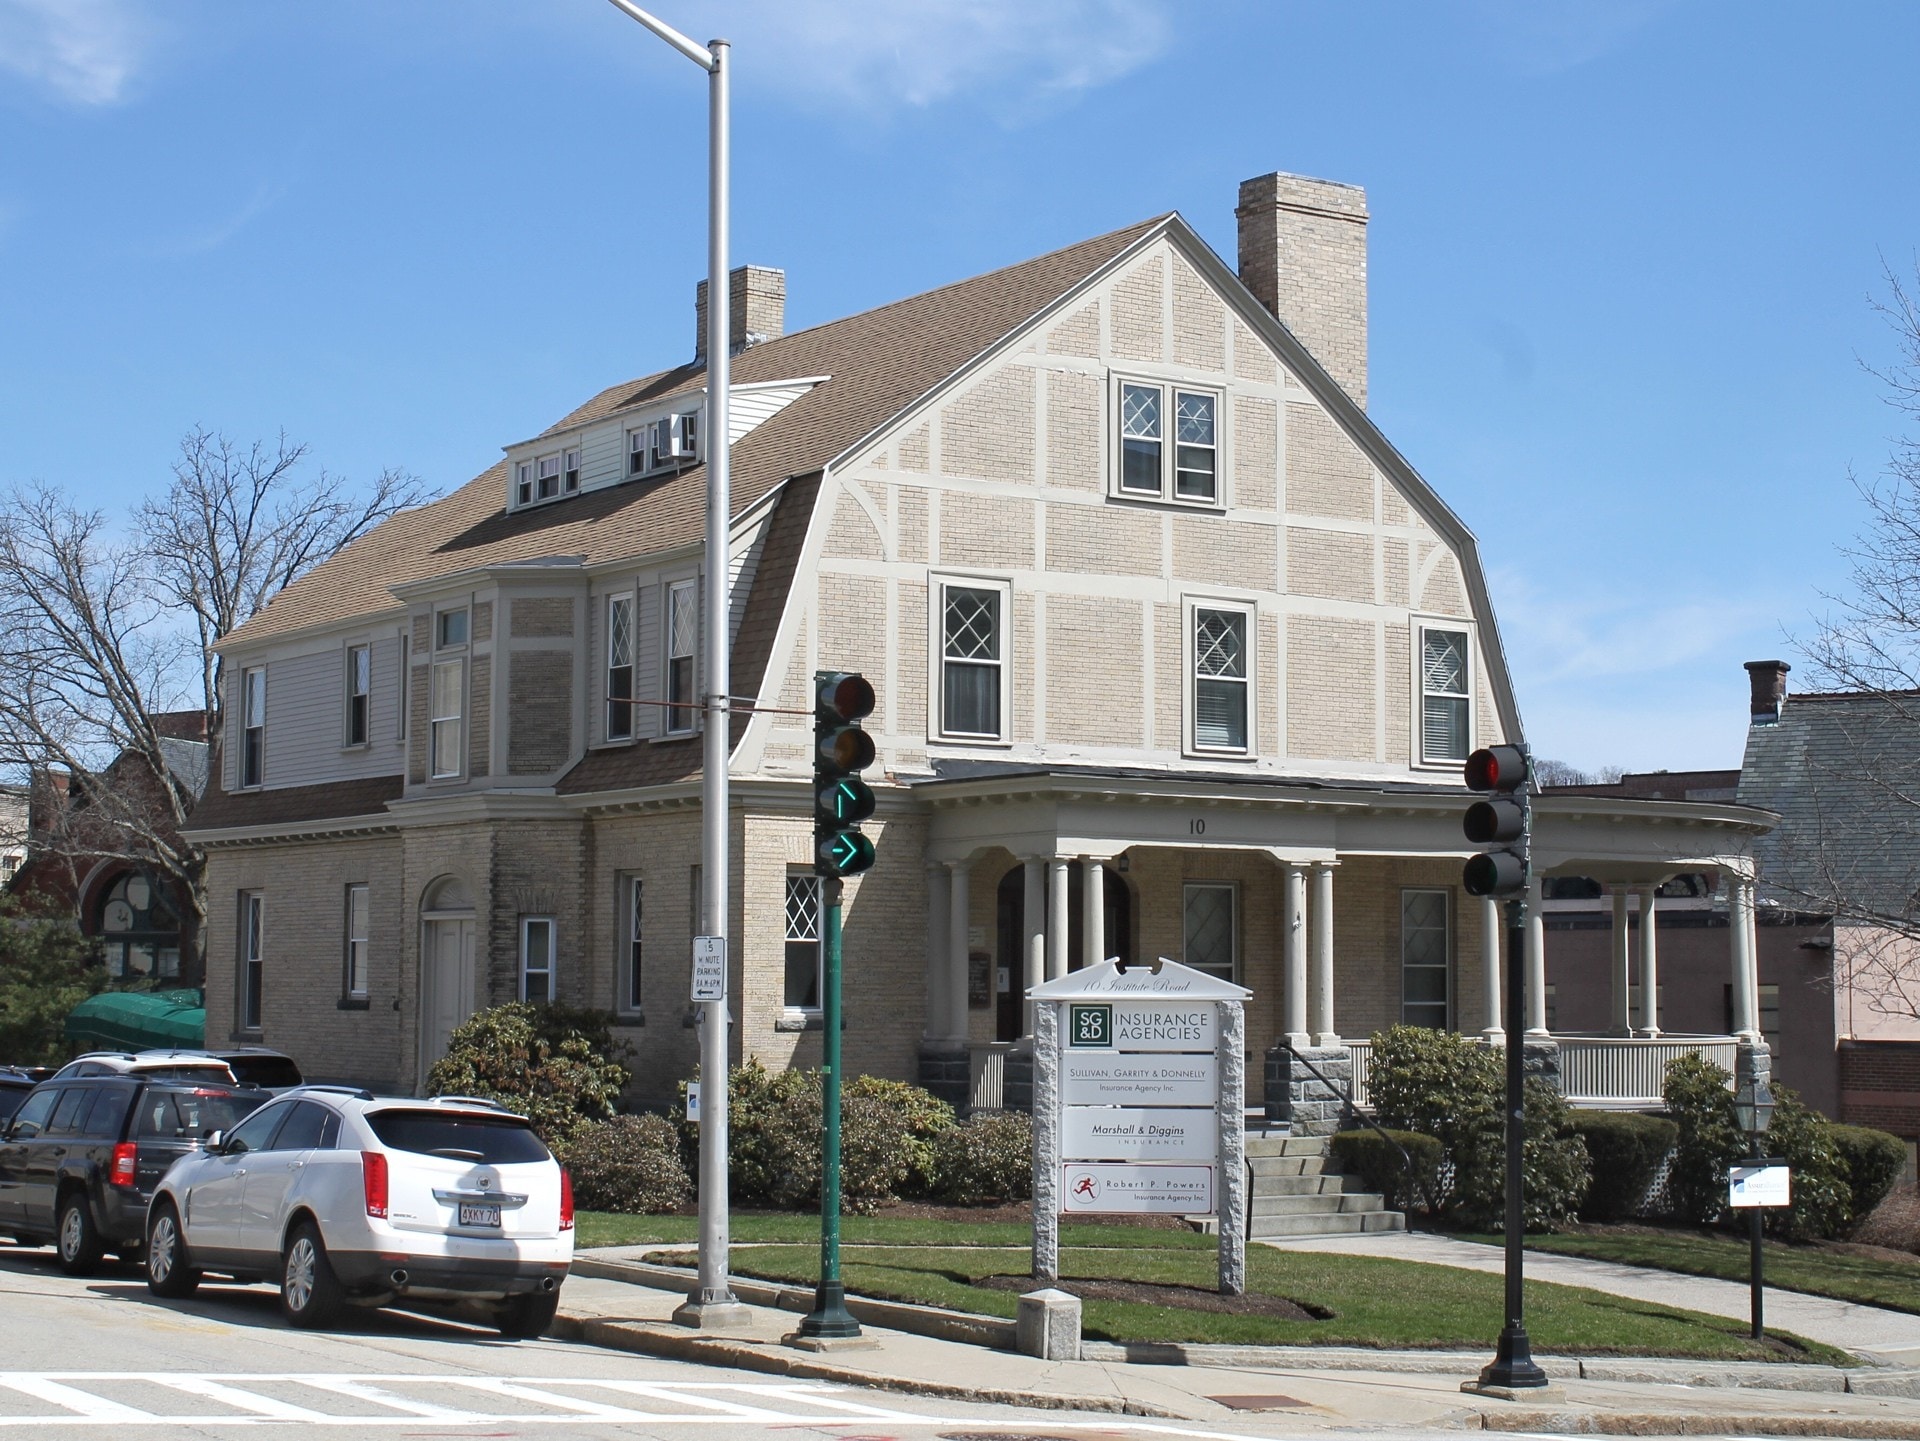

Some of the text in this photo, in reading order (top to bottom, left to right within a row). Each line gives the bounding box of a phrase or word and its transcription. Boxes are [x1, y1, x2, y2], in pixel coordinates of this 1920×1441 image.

[1190, 818, 1205, 835] 10
[698, 955, 720, 964] MNUTE
[696, 967, 721, 976] PARKING
[1083, 978, 1191, 992] 10 Institute Road
[1080, 1012, 1102, 1026] SG
[1115, 1013, 1208, 1026] INSURANCE
[1080, 1026, 1102, 1039] &D
[1119, 1027, 1201, 1040] AGENCIES
[1070, 1068, 1206, 1078] SULLIVAN, GARRITY & DONNELLY
[1099, 1084, 1176, 1093] Insurance Agency Inc.
[1092, 1124, 1185, 1137] Marshall & Diggins
[1106, 1180, 1205, 1189] Robert P. Powers
[1134, 1193, 1165, 1201] Insurance
[1167, 1194, 1192, 1202] Agency
[487, 1210, 499, 1222] 70
